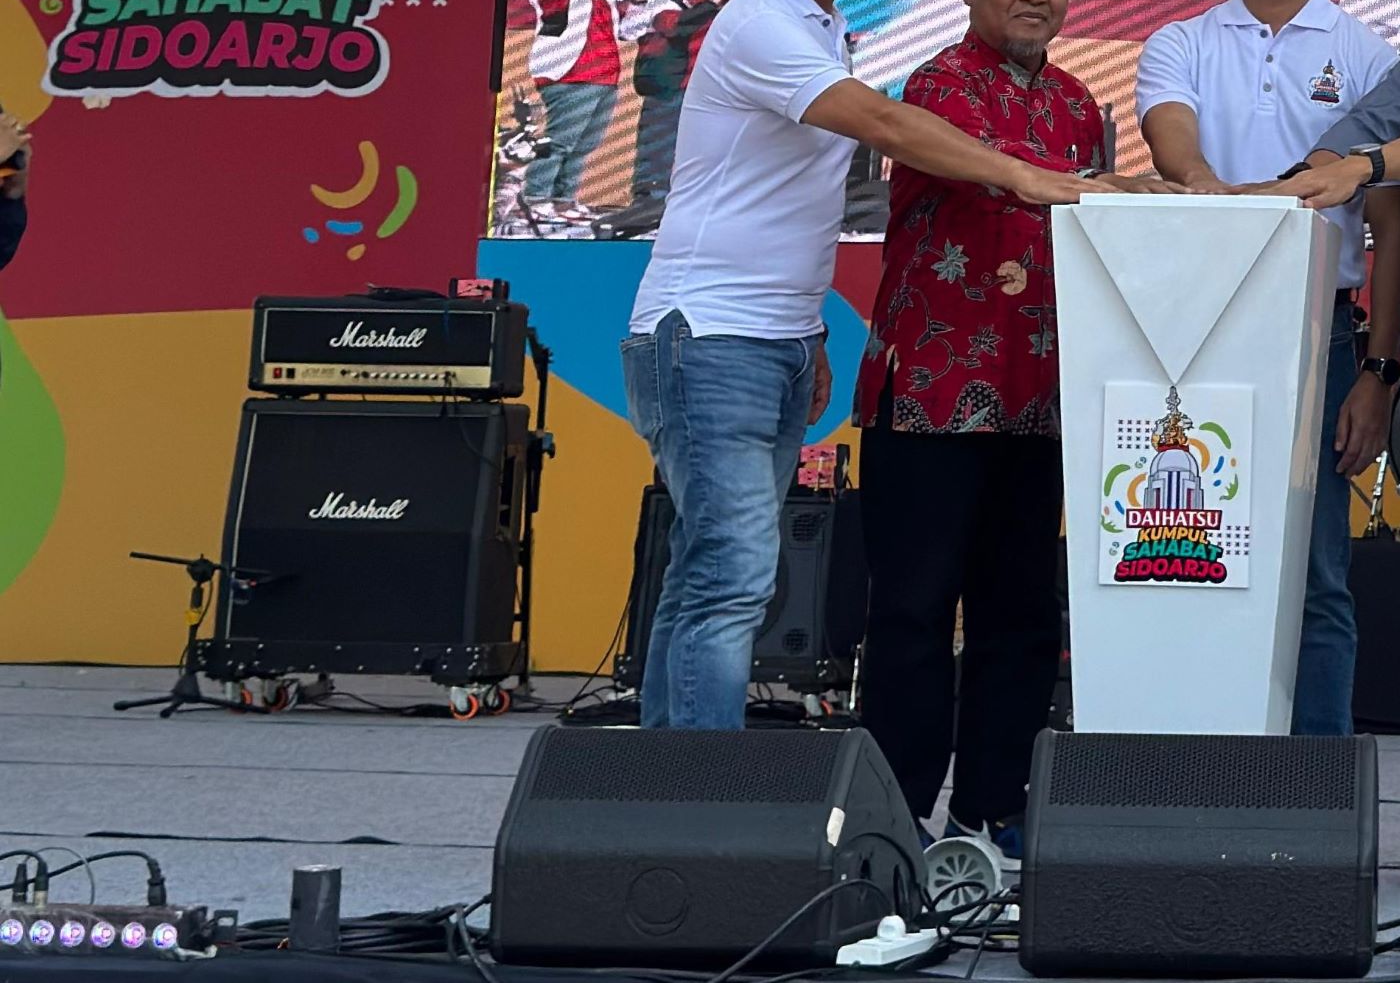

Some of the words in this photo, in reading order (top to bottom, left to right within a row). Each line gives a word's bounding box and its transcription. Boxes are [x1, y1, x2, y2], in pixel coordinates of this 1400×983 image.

[58, 19, 375, 74] SIDOARJO
[330, 321, 427, 348] Marshall
[309, 491, 409, 520] Marshall
[1128, 511, 1219, 527] DAIHATSU
[1138, 526, 1209, 544] KUMPUL
[1124, 540, 1222, 561] SAHABAT
[1116, 559, 1225, 578] SIDOARJO
